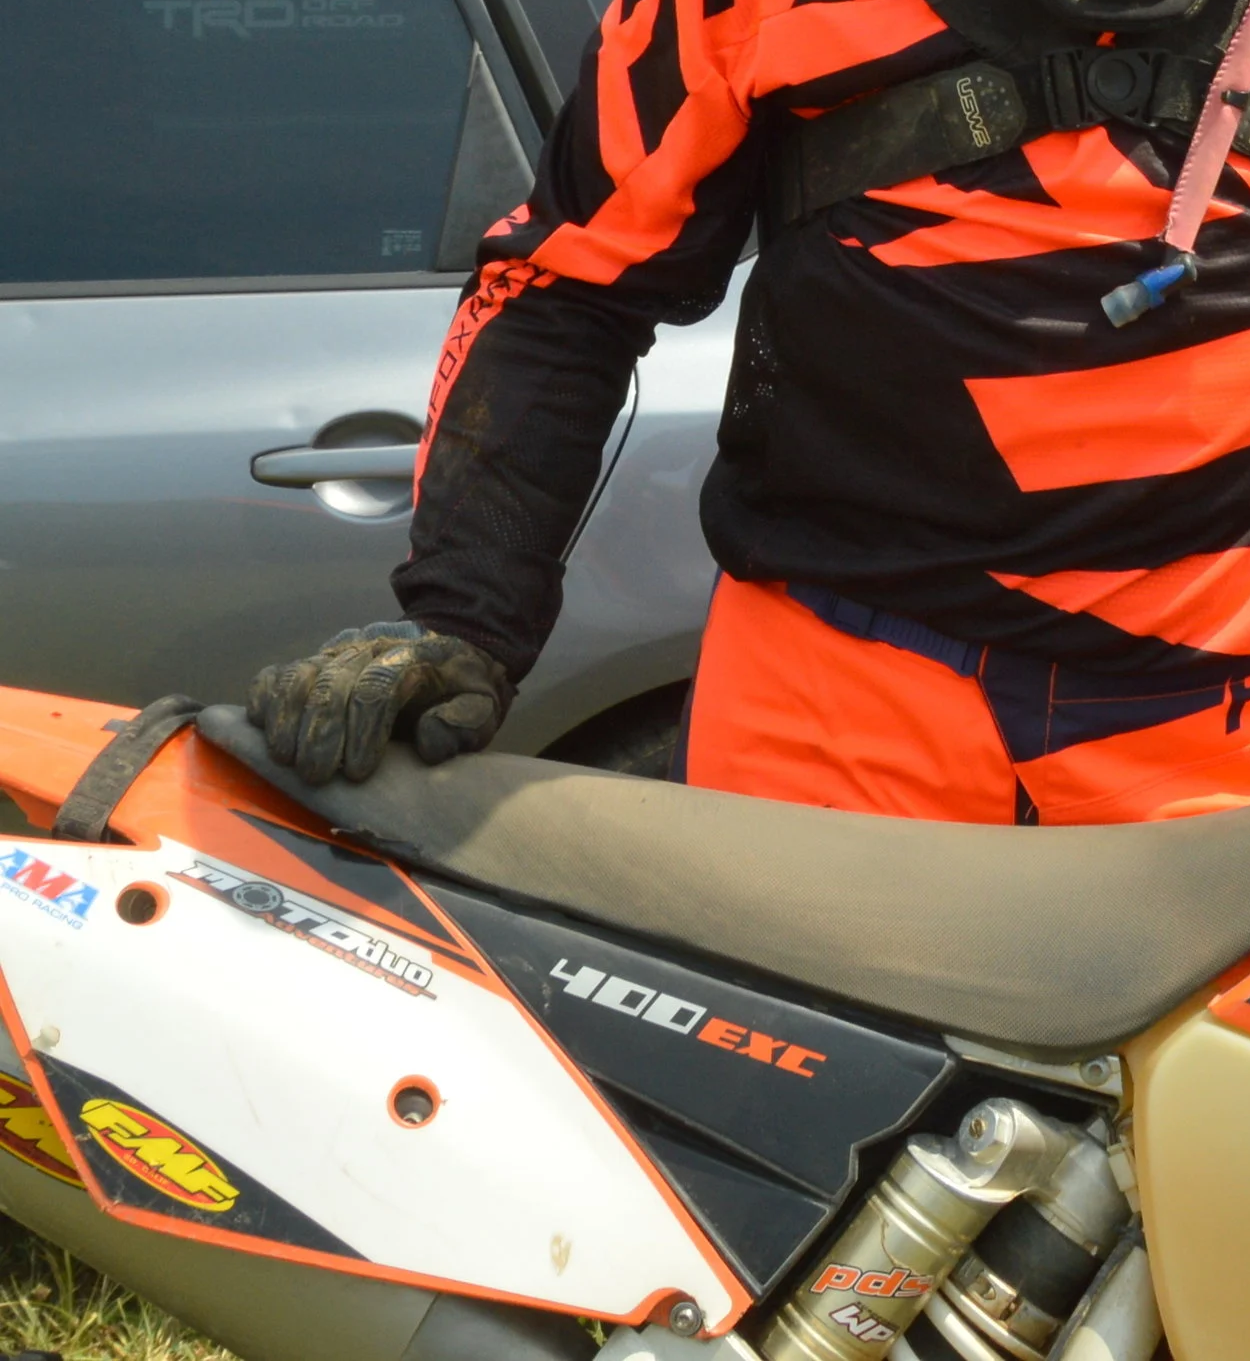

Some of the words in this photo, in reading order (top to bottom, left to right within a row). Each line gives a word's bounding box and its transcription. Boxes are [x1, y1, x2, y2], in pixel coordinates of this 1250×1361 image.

[956, 77, 991, 147] USWE
[549, 958, 707, 1035] 400
[696, 1016, 827, 1078] EXC
[79, 1101, 241, 1204] FMF
[810, 1262, 935, 1298] pds
[829, 1302, 896, 1343] WP
